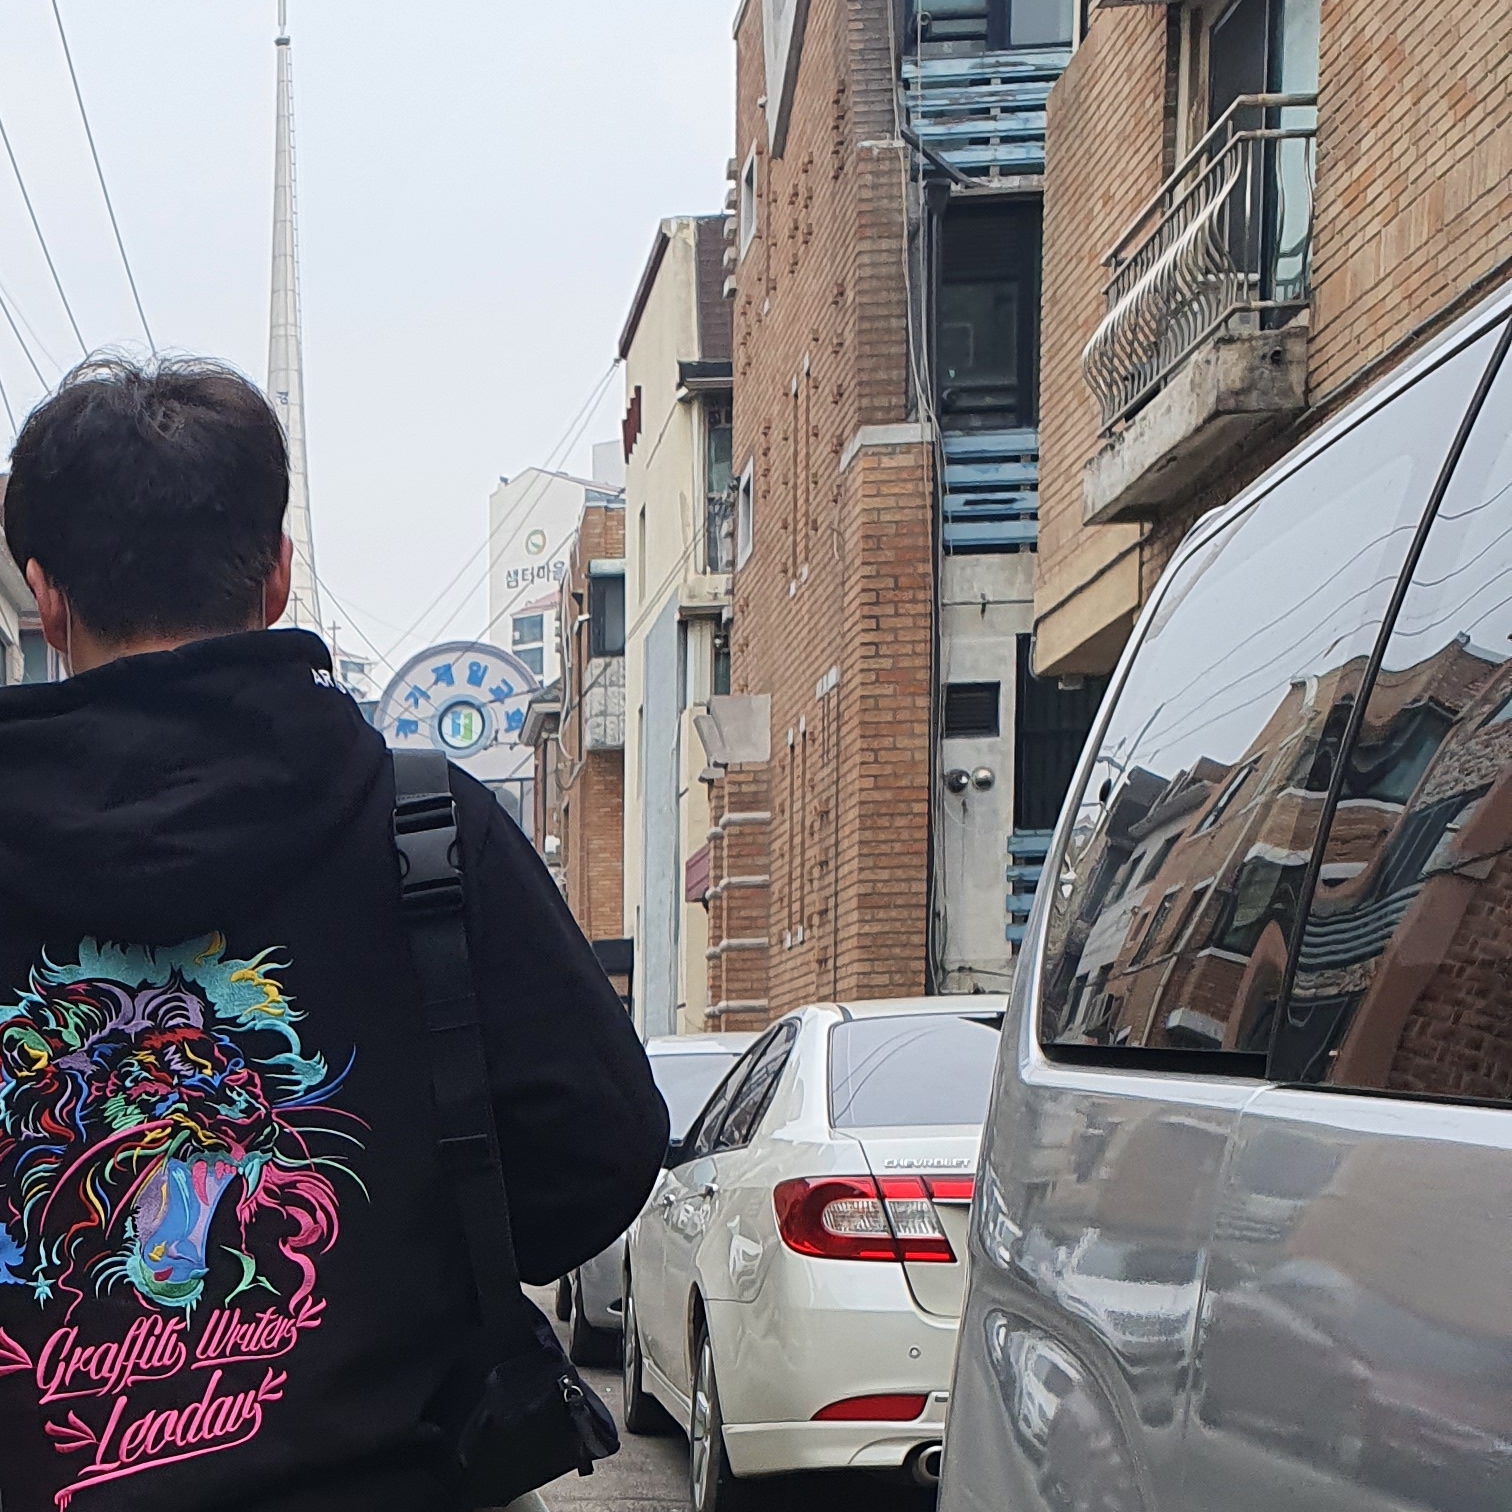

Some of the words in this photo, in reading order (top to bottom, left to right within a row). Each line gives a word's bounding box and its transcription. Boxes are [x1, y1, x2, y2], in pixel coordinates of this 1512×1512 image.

[505, 561, 565, 589] 샘터마을
[884, 1158, 970, 1168] CHEVROLET
[36, 1314, 186, 1404] Graffiti
